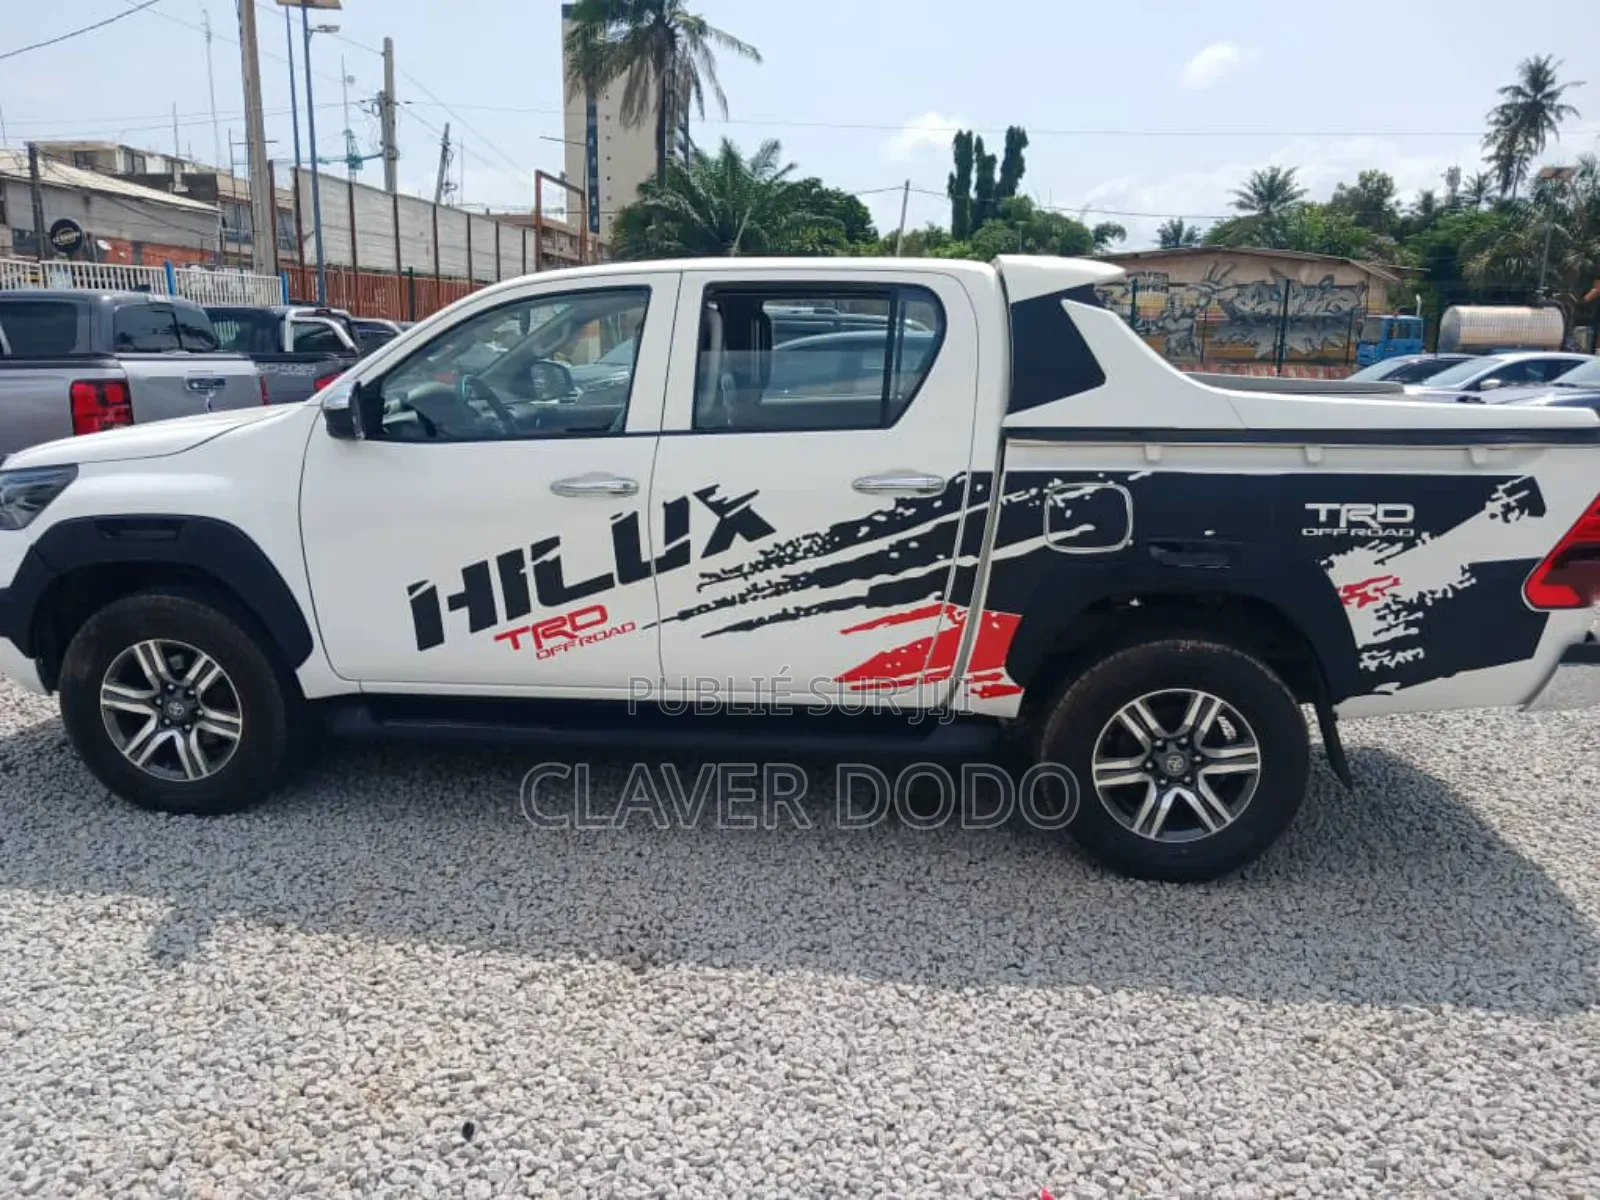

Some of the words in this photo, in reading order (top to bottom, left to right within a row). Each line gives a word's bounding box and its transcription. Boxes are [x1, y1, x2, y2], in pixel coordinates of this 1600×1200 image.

[1304, 503, 1415, 528] TRD
[407, 484, 777, 652] HILUX
[494, 604, 609, 651] TRD
